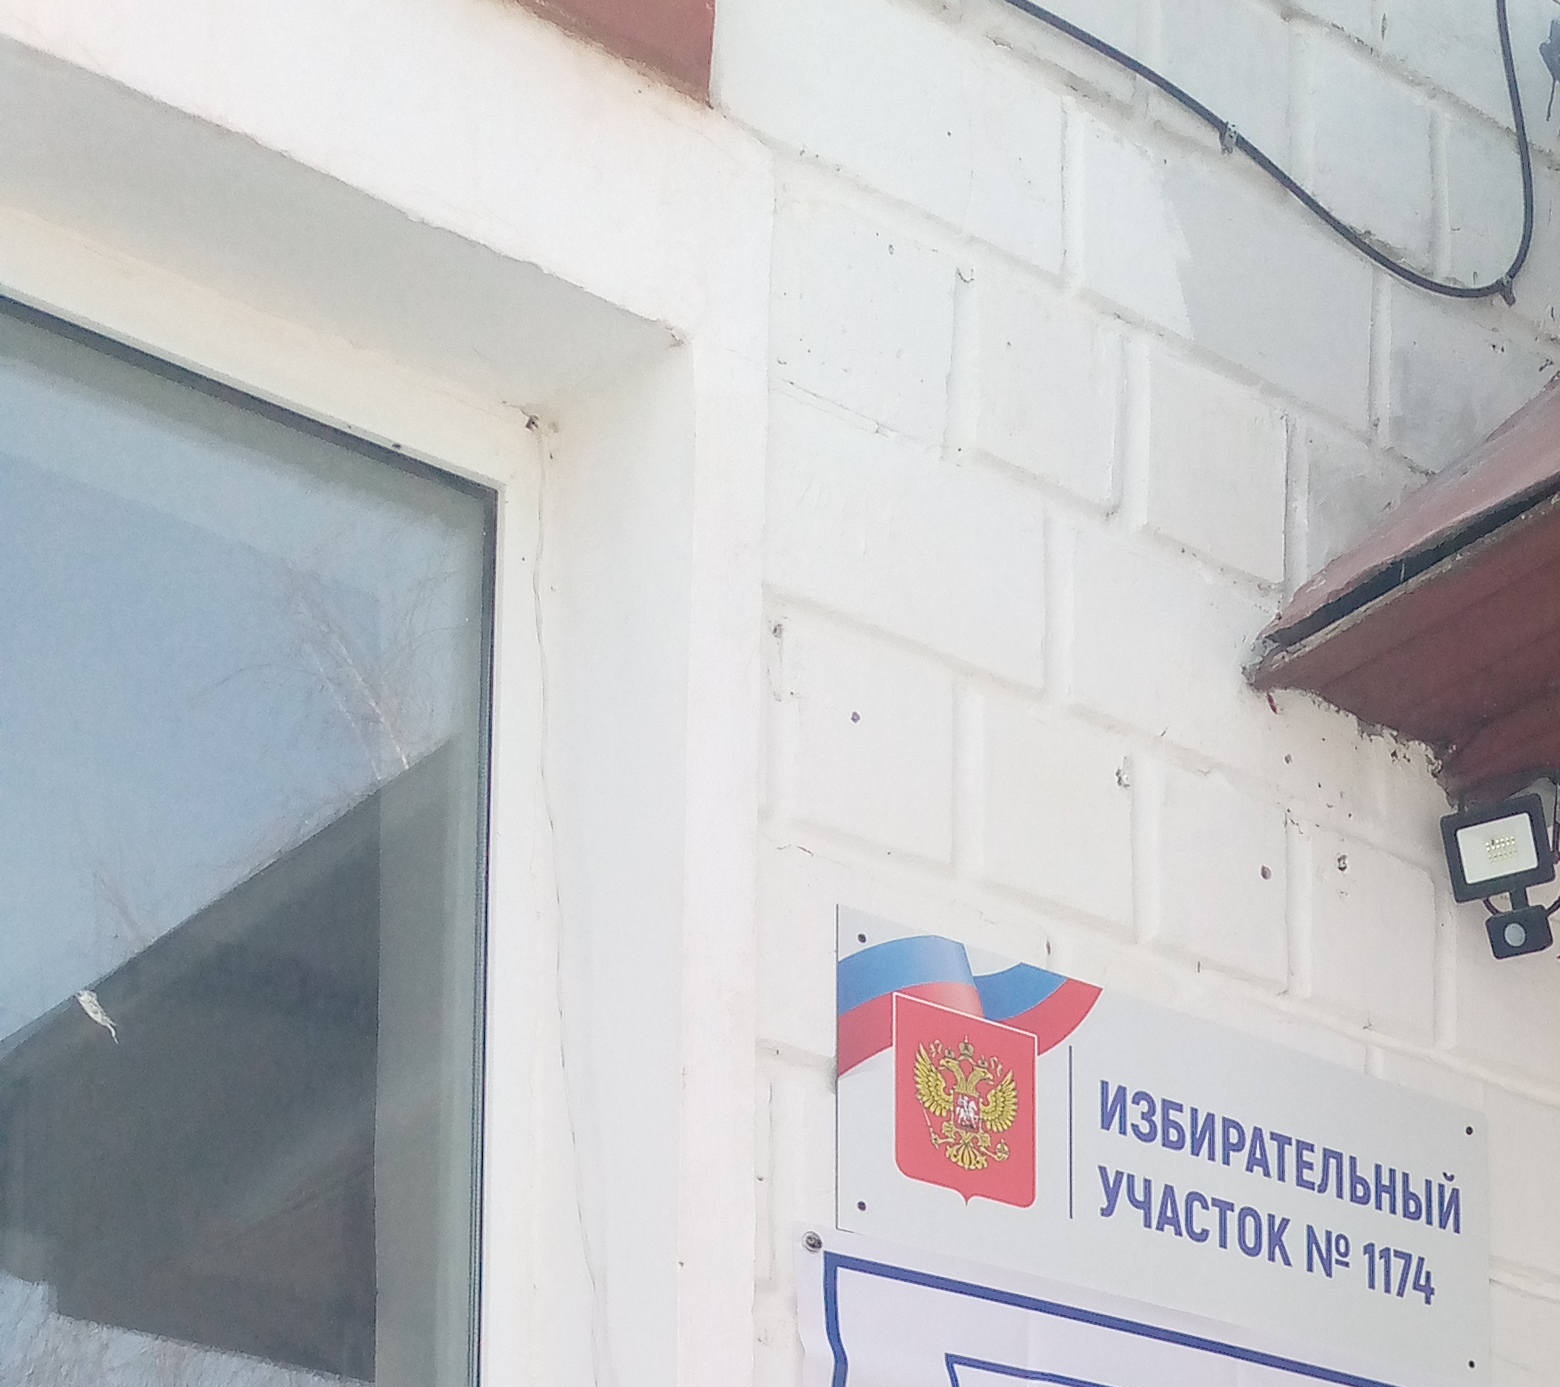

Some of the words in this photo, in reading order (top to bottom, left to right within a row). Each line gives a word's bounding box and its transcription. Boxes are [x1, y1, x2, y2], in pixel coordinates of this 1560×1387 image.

[1099, 1078, 1463, 1235] ИЗБИРАТЕЛЬНЫЙ
[1097, 1164, 1293, 1268] УЧАСТОК
[1305, 1224, 1352, 1280] №
[1362, 1242, 1436, 1306] 1174
